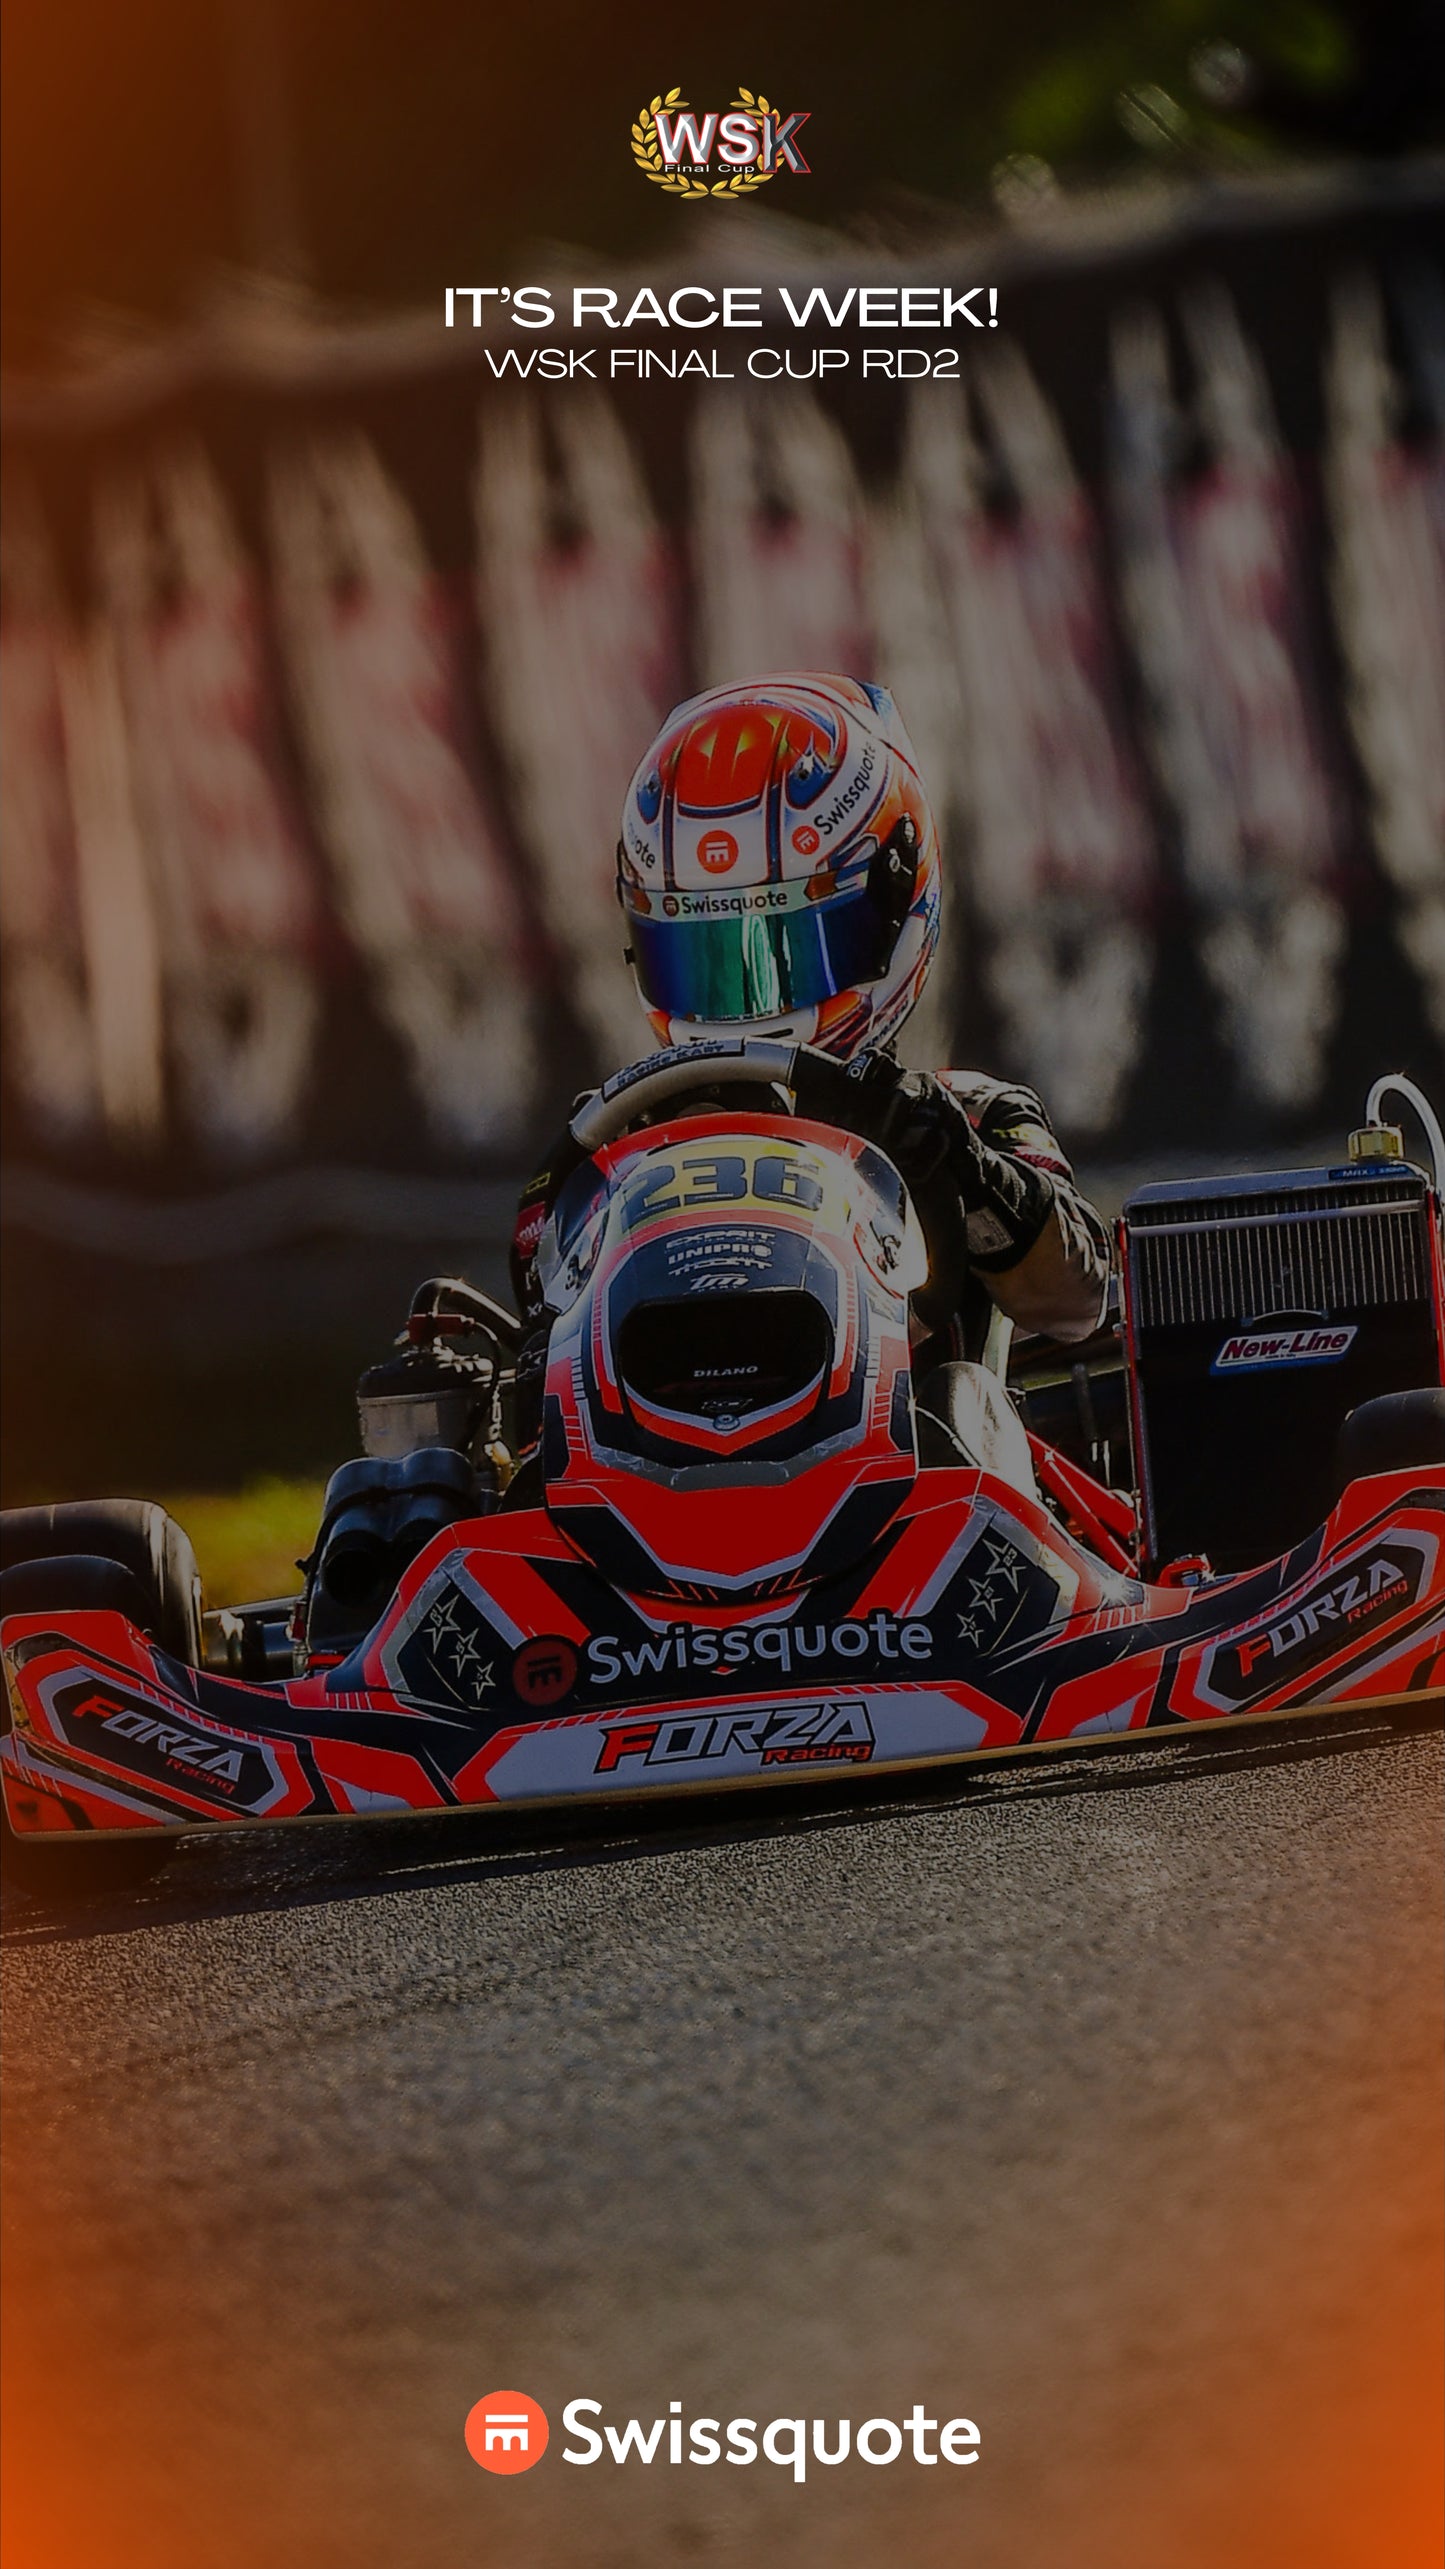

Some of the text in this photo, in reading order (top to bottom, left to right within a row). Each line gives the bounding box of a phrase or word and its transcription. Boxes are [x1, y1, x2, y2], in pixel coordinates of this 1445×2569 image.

[814, 741, 878, 836] Swissquote
[682, 890, 788, 914] Swissquote
[622, 1156, 823, 1234] 236
[693, 1365, 759, 1378] DILANO
[1222, 1331, 1348, 1360] New-Line
[1236, 1559, 1404, 1677] FORZA
[1347, 1579, 1408, 1624] Racing
[588, 1613, 933, 1684] Swissquote
[72, 1694, 247, 1783] FORZA
[597, 1702, 874, 1772] FORZA
[762, 1743, 871, 1765] Racing
[165, 1757, 236, 1795] Racing
